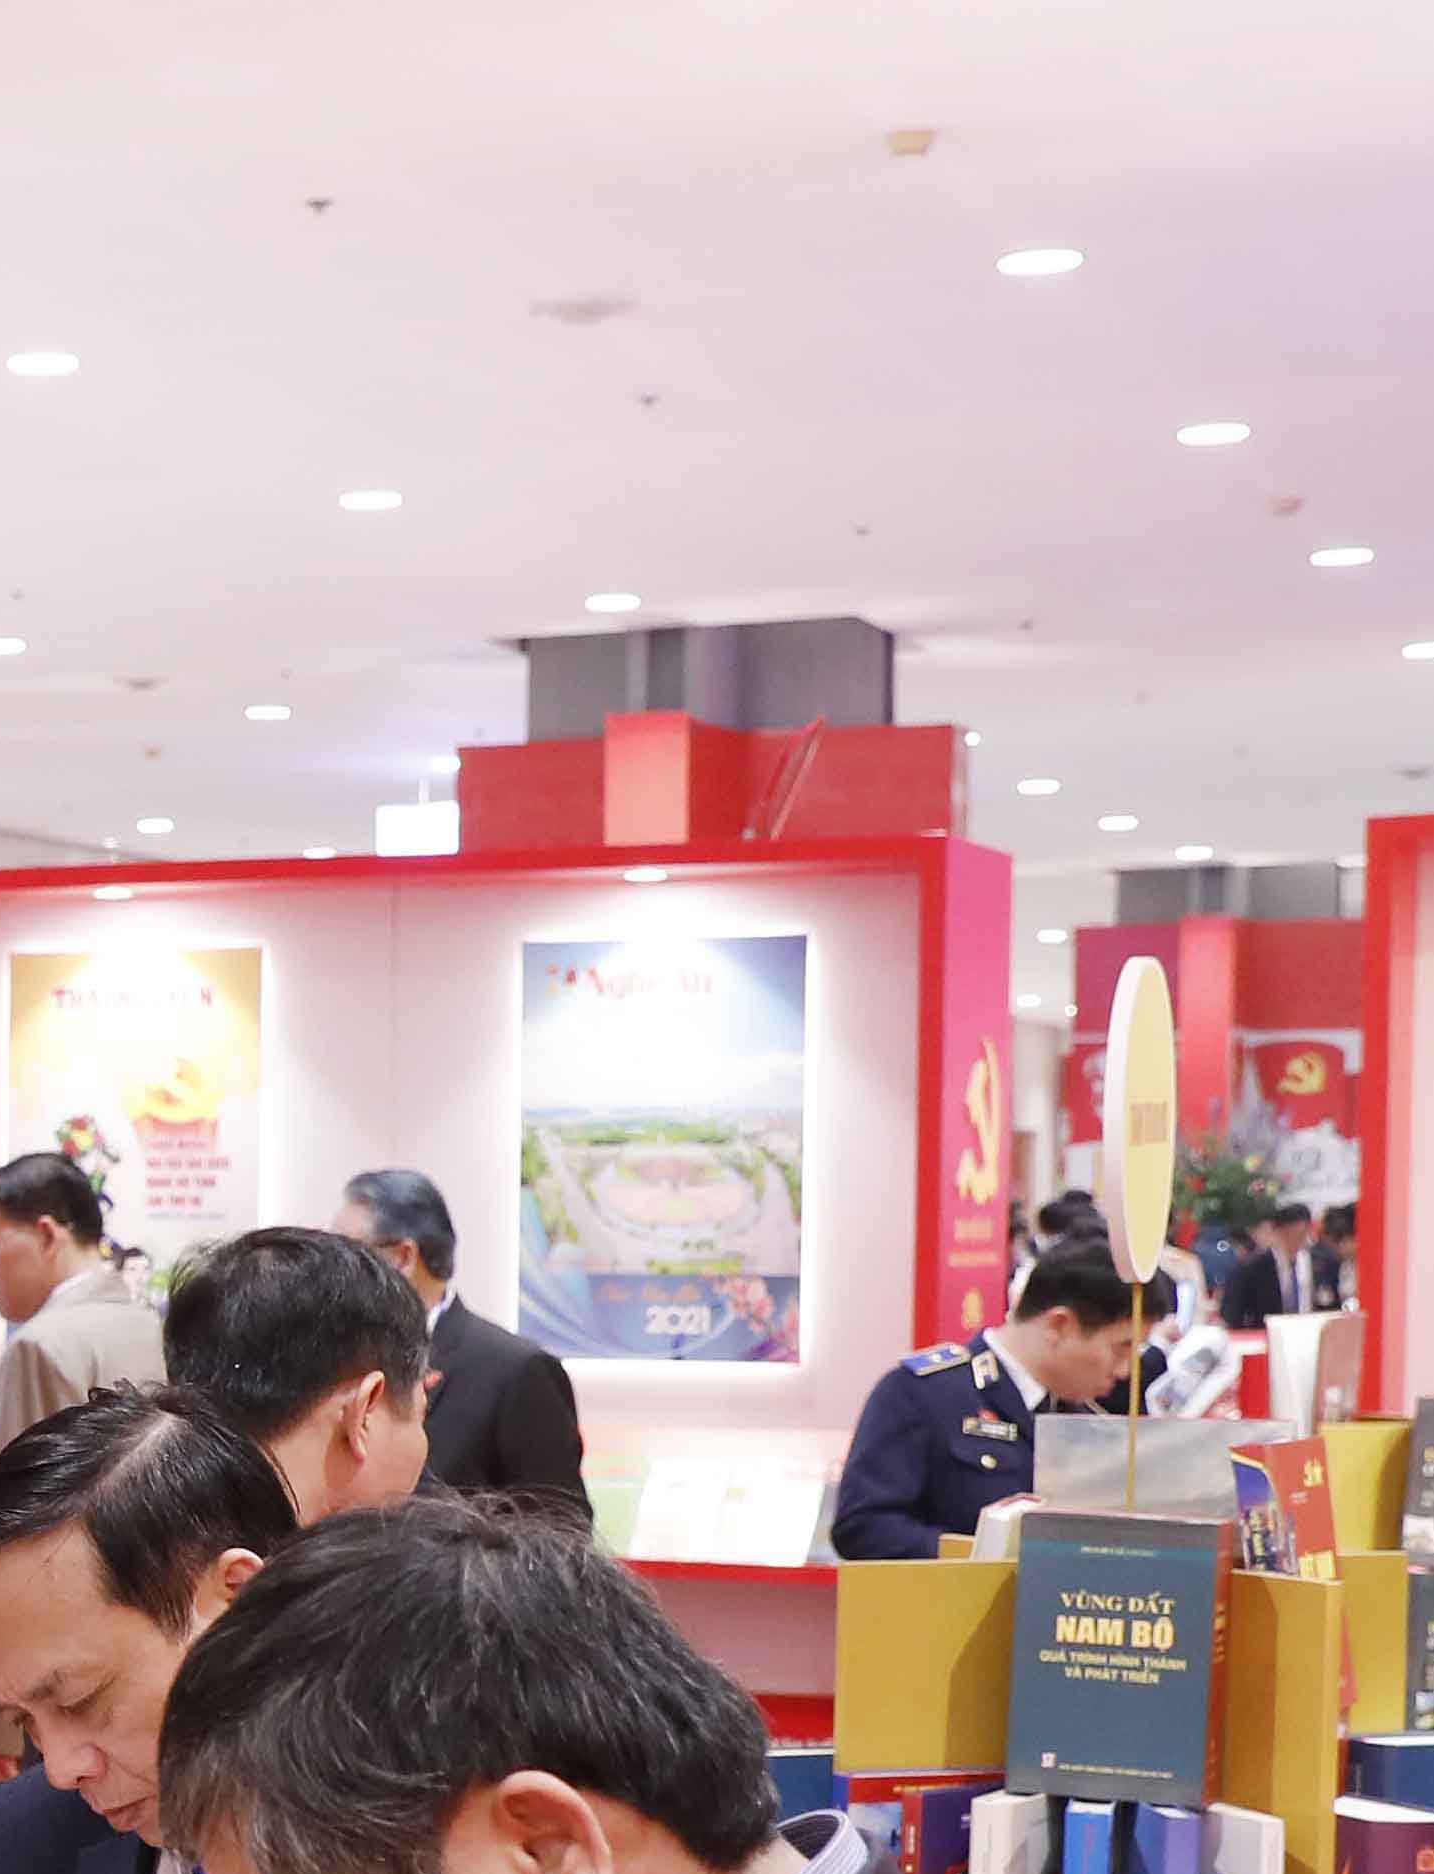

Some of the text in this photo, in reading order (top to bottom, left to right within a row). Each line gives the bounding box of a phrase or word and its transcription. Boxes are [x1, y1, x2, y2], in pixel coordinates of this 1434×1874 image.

[645, 1305, 711, 1335] 2021
[1060, 1589, 1175, 1615] VÙNG ĐẤT
[1056, 1614, 1175, 1653] NAM BỘ
